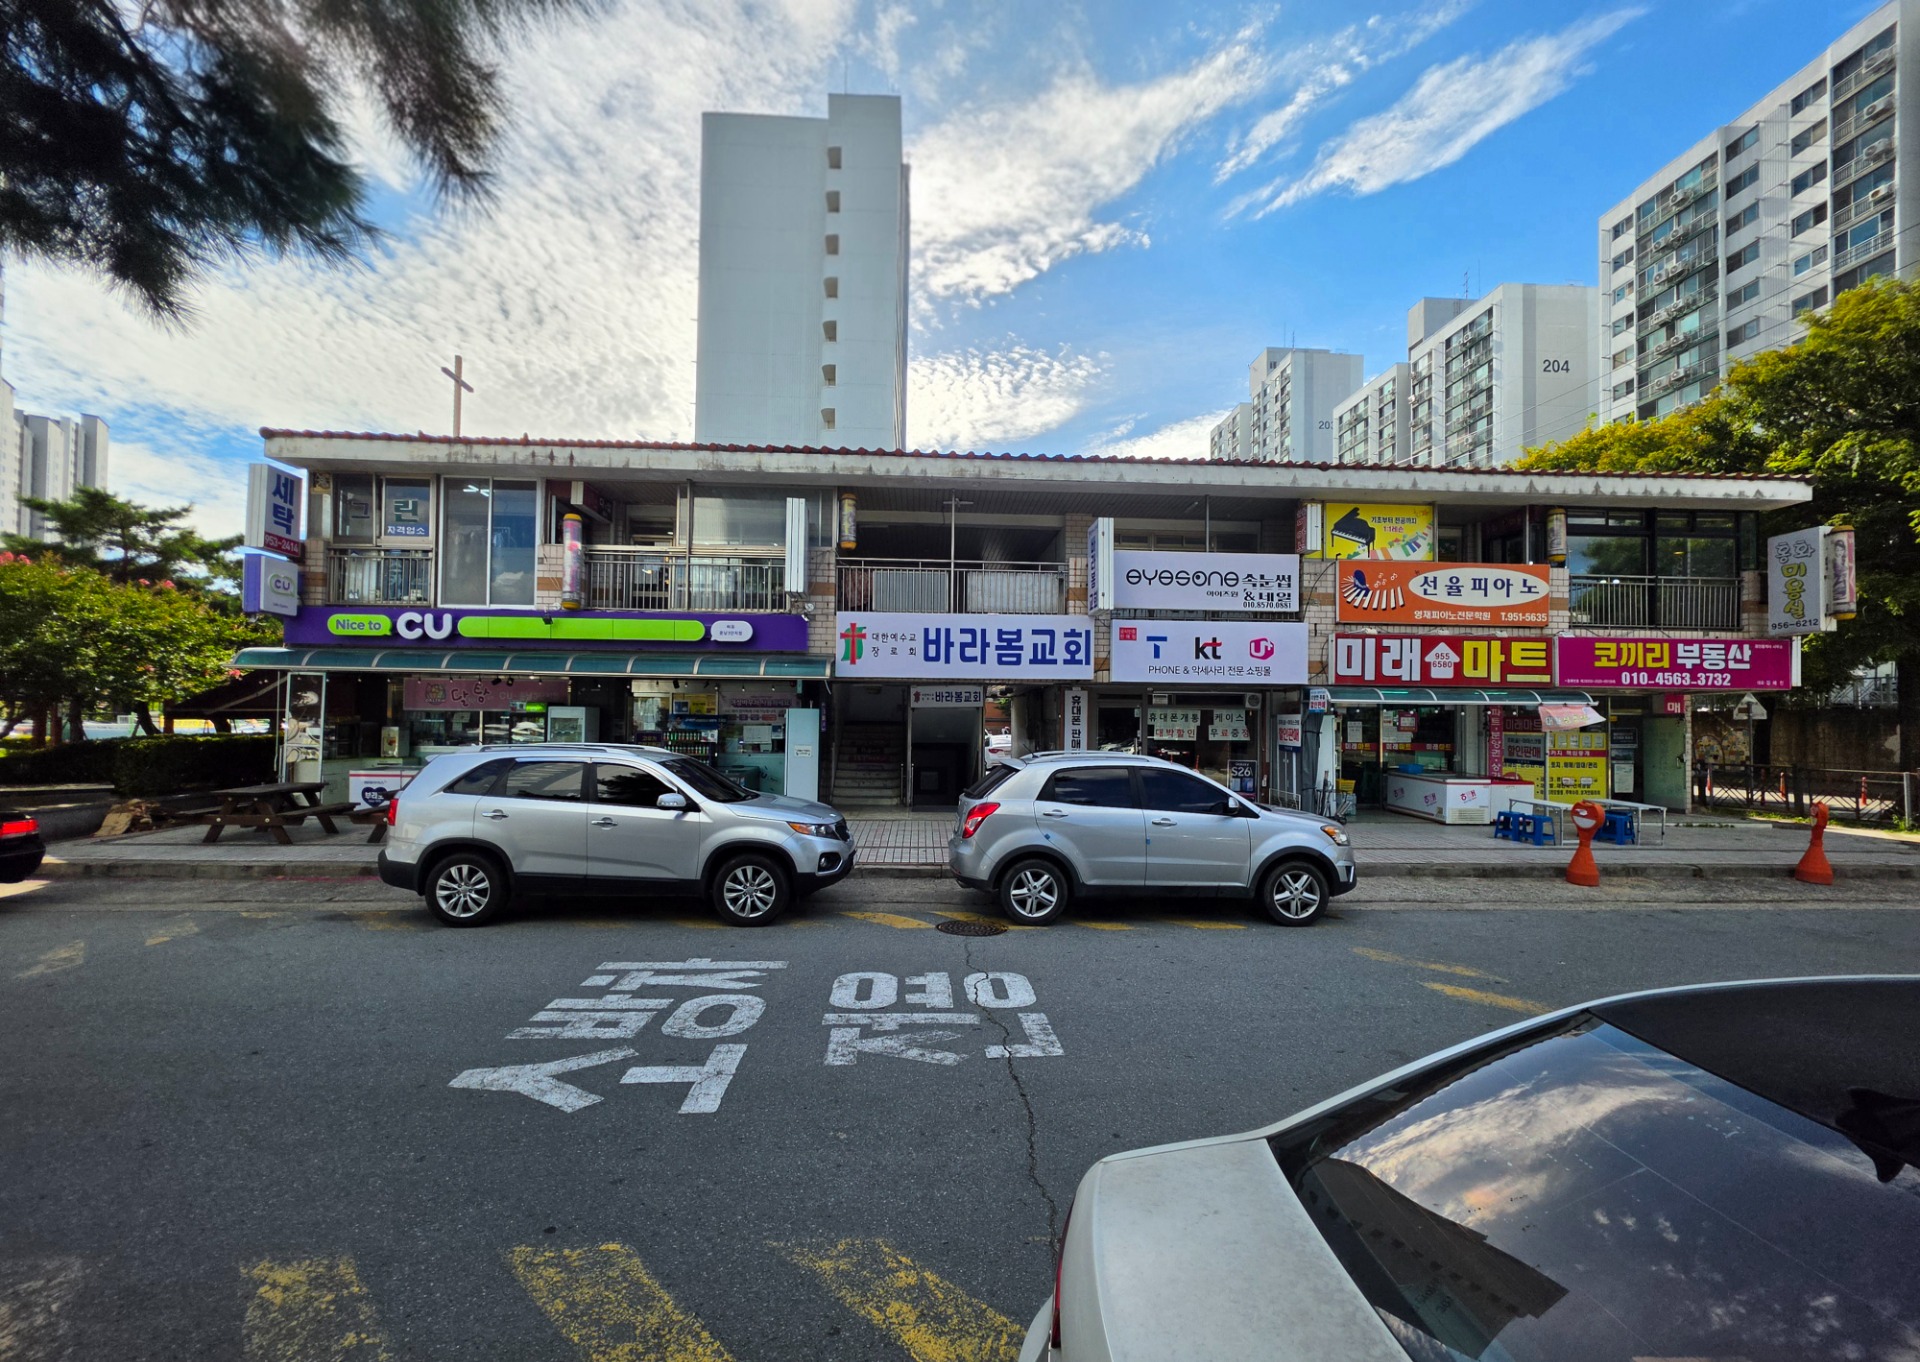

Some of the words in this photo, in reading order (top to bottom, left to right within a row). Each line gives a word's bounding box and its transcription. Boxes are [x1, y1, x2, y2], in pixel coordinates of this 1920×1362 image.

[1542, 358, 1570, 374] 204
[271, 473, 295, 535] 세탁
[1371, 516, 1393, 524] 기초부터
[1395, 517, 1417, 525] 전공까지
[387, 525, 425, 535] 자격업소
[264, 535, 299, 553] 953-2414
[274, 579, 291, 590] CU
[1126, 568, 1239, 587] eyesone
[1241, 573, 1292, 589] 속눈썹
[1206, 590, 1239, 598] 아이즈원
[1258, 591, 1292, 602] 네일
[1781, 562, 1807, 619] 미용실
[1414, 610, 1491, 621] 영재피아노전문학원
[1500, 612, 1548, 621] T.951-5635
[335, 619, 365, 630] Nice
[368, 620, 382, 631] to
[396, 611, 453, 640] CU
[1771, 618, 1819, 630] 956-6212
[871, 632, 917, 643] 대한예수교
[922, 627, 1092, 666] 바라봄교회
[1146, 635, 1168, 659] T
[1194, 637, 1223, 660] kt
[1434, 652, 1451, 660] 955
[1594, 642, 1670, 669] 코끼리
[1676, 643, 1752, 670] 부동산
[1432, 660, 1453, 669] 6580
[1148, 665, 1181, 675] PHONE
[1183, 665, 1190, 674] &
[1191, 665, 1225, 676] 악세사리
[1227, 666, 1245, 676] 전문
[1246, 666, 1271, 677] 쇼핑몰
[1621, 671, 1731, 687] 010-4563-3732
[935, 691, 981, 703] 바라봄교회
[1071, 695, 1082, 726] 휴대폰
[1667, 702, 1681, 714] 매
[1214, 713, 1245, 723] 케이스
[1071, 729, 1082, 749] 판매
[1155, 728, 1196, 738] 대박할인
[1426, 743, 1453, 751] 미래마트
[1508, 745, 1541, 758] 할인판매
[1231, 766, 1251, 777] S26
